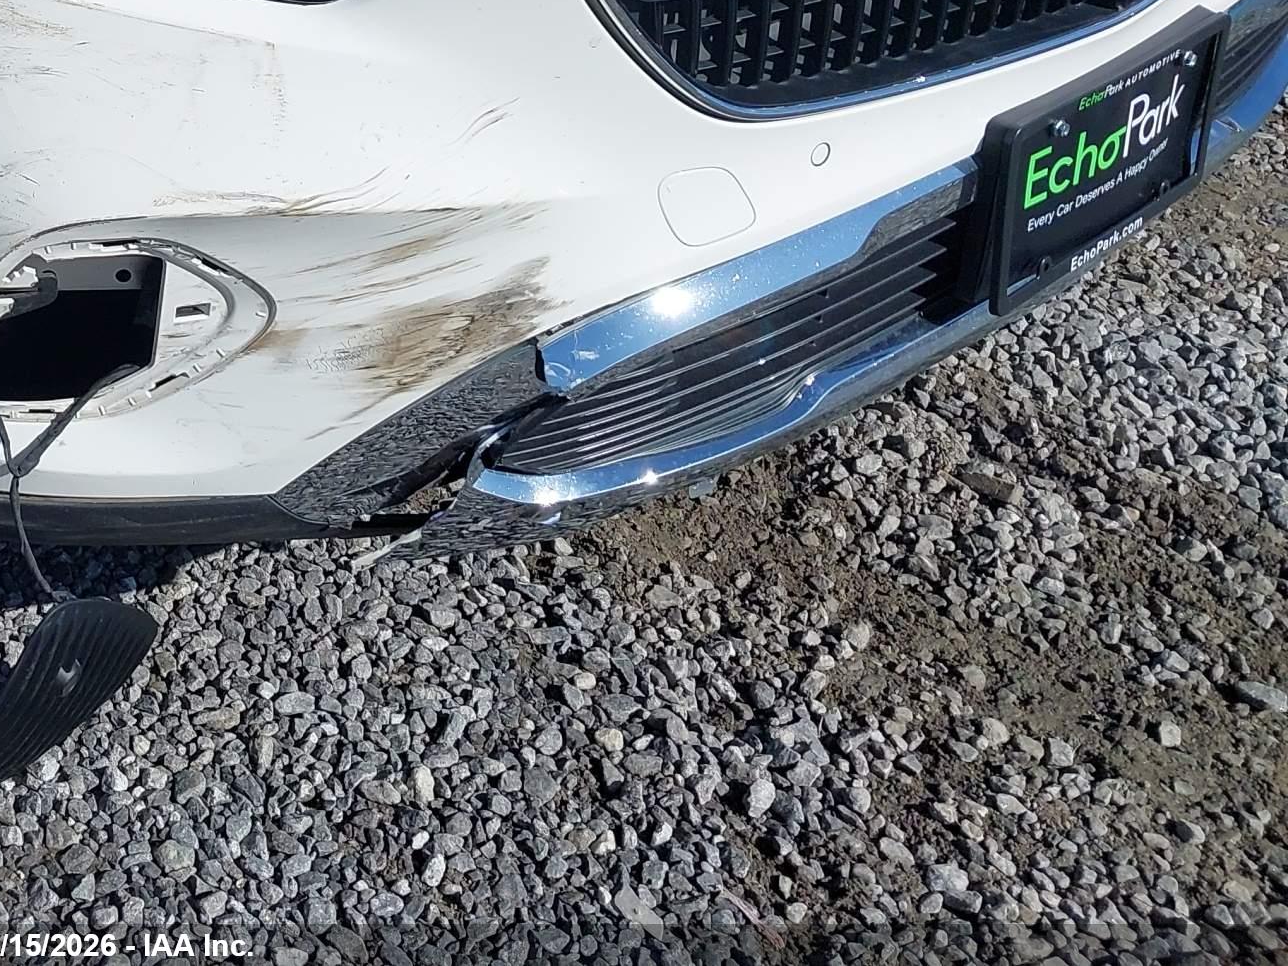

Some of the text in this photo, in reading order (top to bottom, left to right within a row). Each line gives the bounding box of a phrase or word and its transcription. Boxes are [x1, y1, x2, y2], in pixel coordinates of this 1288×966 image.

[1078, 48, 1182, 111] EchoPark AUTOMOTIVE
[1023, 73, 1186, 211] EchoPark
[1027, 137, 1169, 233] Every Car Deserves A Happy Owner
[1070, 216, 1143, 273] EchoPark.com
